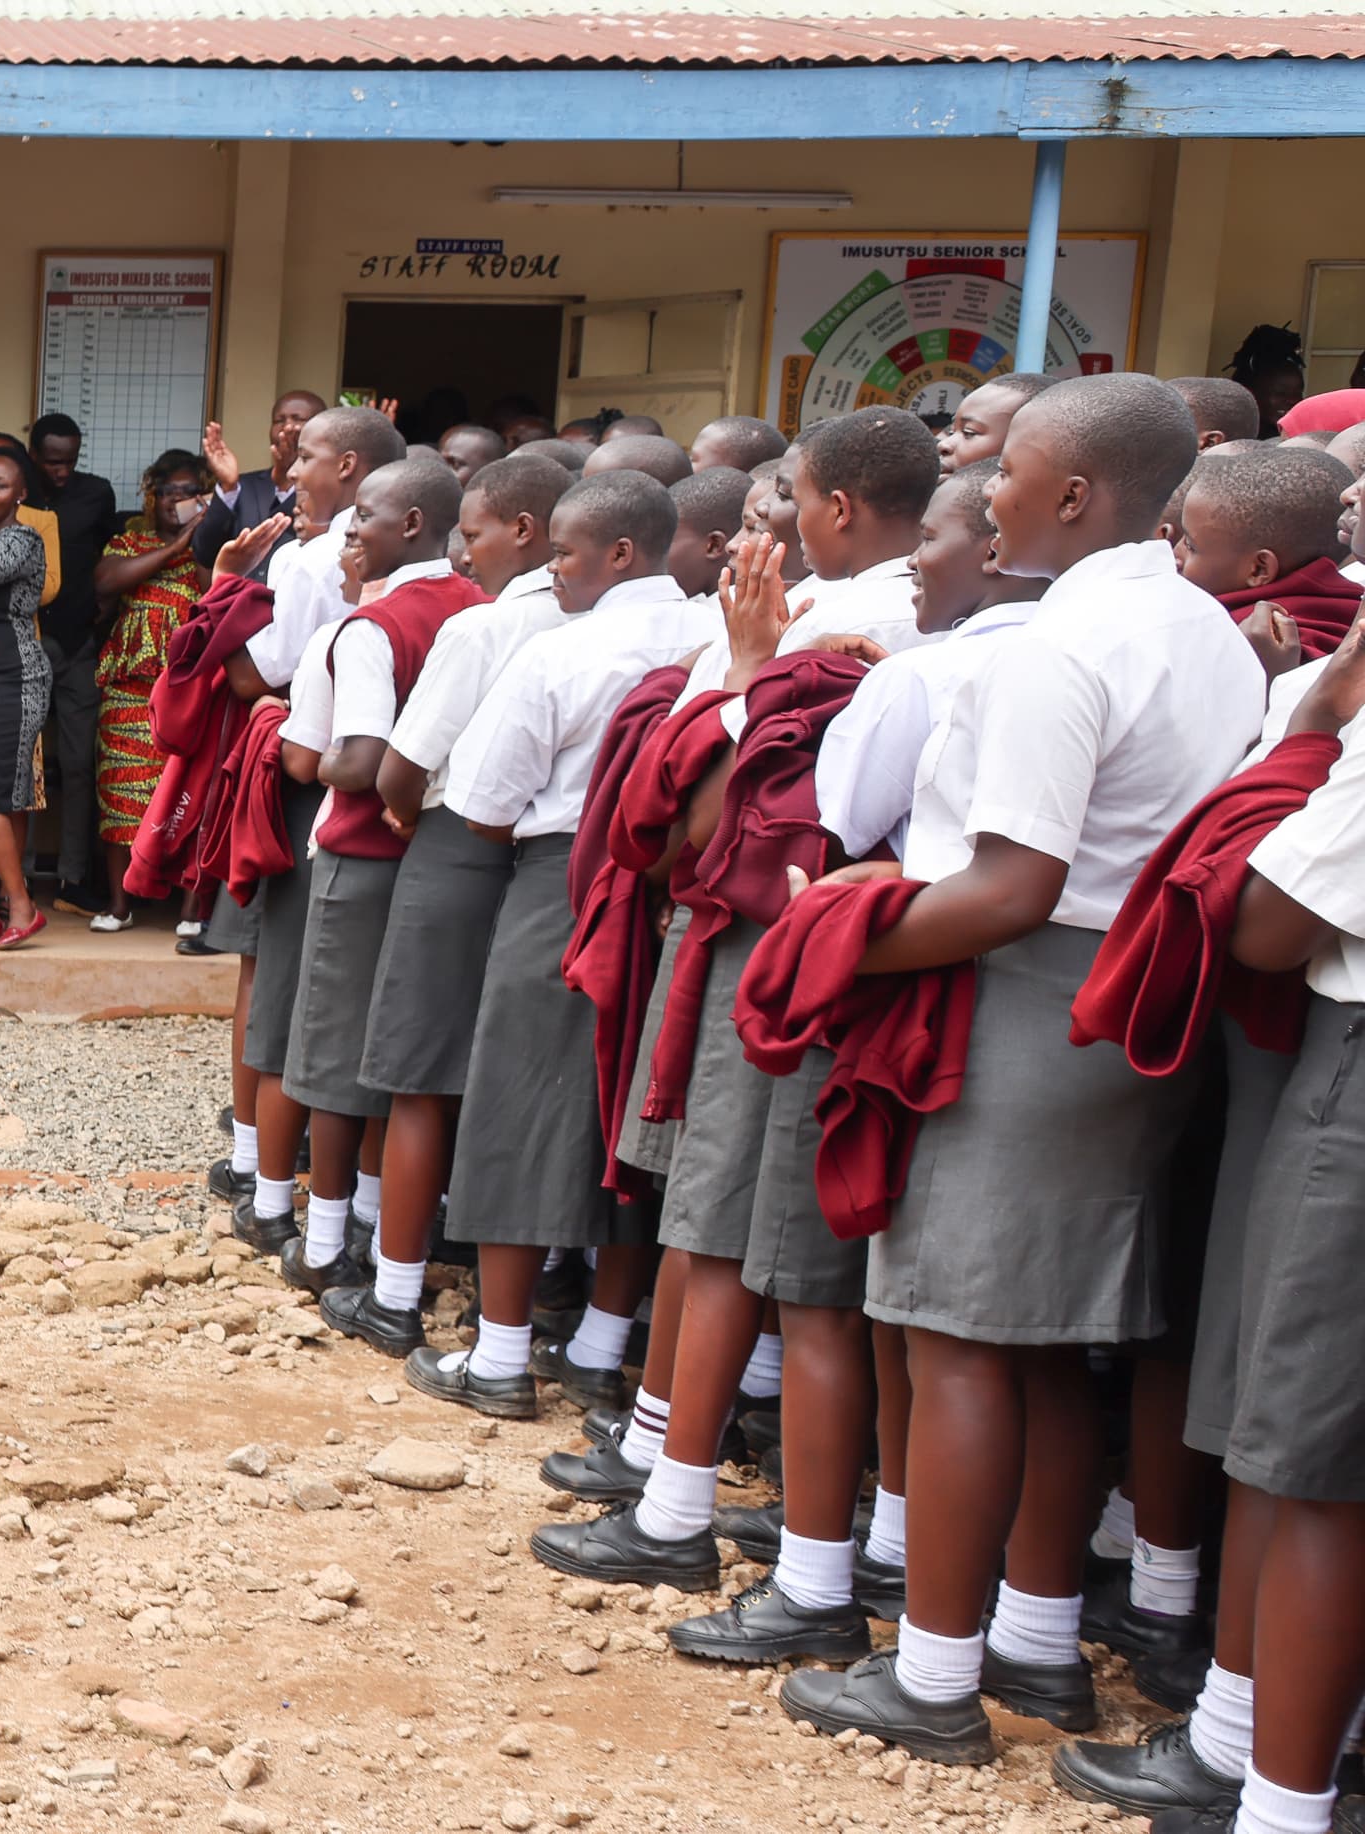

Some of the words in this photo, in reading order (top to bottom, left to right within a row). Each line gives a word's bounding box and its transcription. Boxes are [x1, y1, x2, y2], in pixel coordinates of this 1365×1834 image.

[419, 241, 459, 251] STAFF
[463, 241, 501, 251] ROOM
[842, 246, 928, 258] IMUSUTSU
[933, 246, 994, 258] SENIOR
[360, 255, 453, 279] STAFF
[466, 255, 561, 279] ROOM
[69, 272, 119, 286] IMUSUTSU
[121, 272, 151, 286] MIXED
[174, 272, 211, 286] SCHOOL
[72, 294, 115, 305] SCHOOL
[117, 294, 185, 305] ENROLLMENT
[812, 309, 845, 337] TEAM
[843, 282, 877, 311] WORK
[1067, 315, 1092, 344] GOAL
